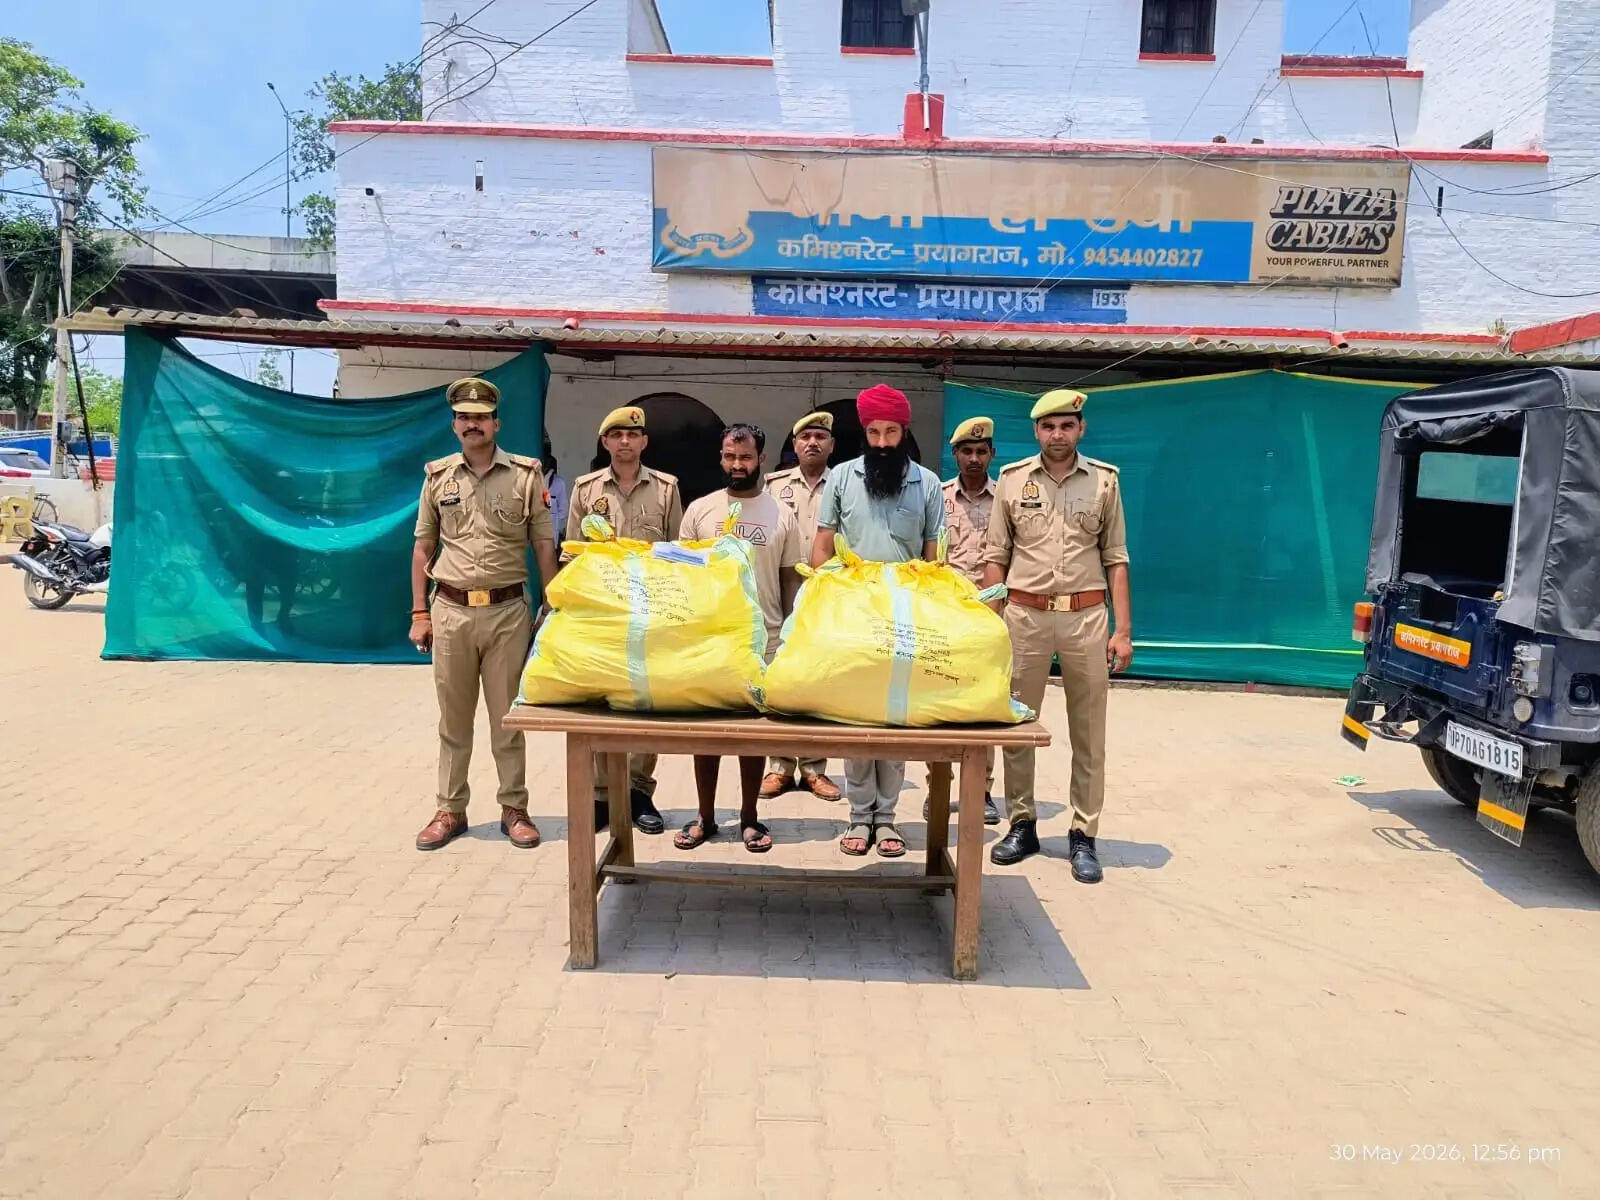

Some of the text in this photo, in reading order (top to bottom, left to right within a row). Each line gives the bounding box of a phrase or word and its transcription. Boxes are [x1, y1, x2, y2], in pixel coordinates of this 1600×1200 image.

[1270, 186, 1398, 221] PLAZA
[1266, 221, 1395, 254] CABLES
[913, 244, 1029, 267] प्रयागराज,
[1037, 241, 1075, 266] मो.
[1084, 248, 1204, 268] 9454402827
[1266, 256, 1389, 268] YOUR POWERFUL PARTNER
[915, 283, 1049, 313] प्रयागराज
[1449, 729, 1520, 770] UP70AG1815
